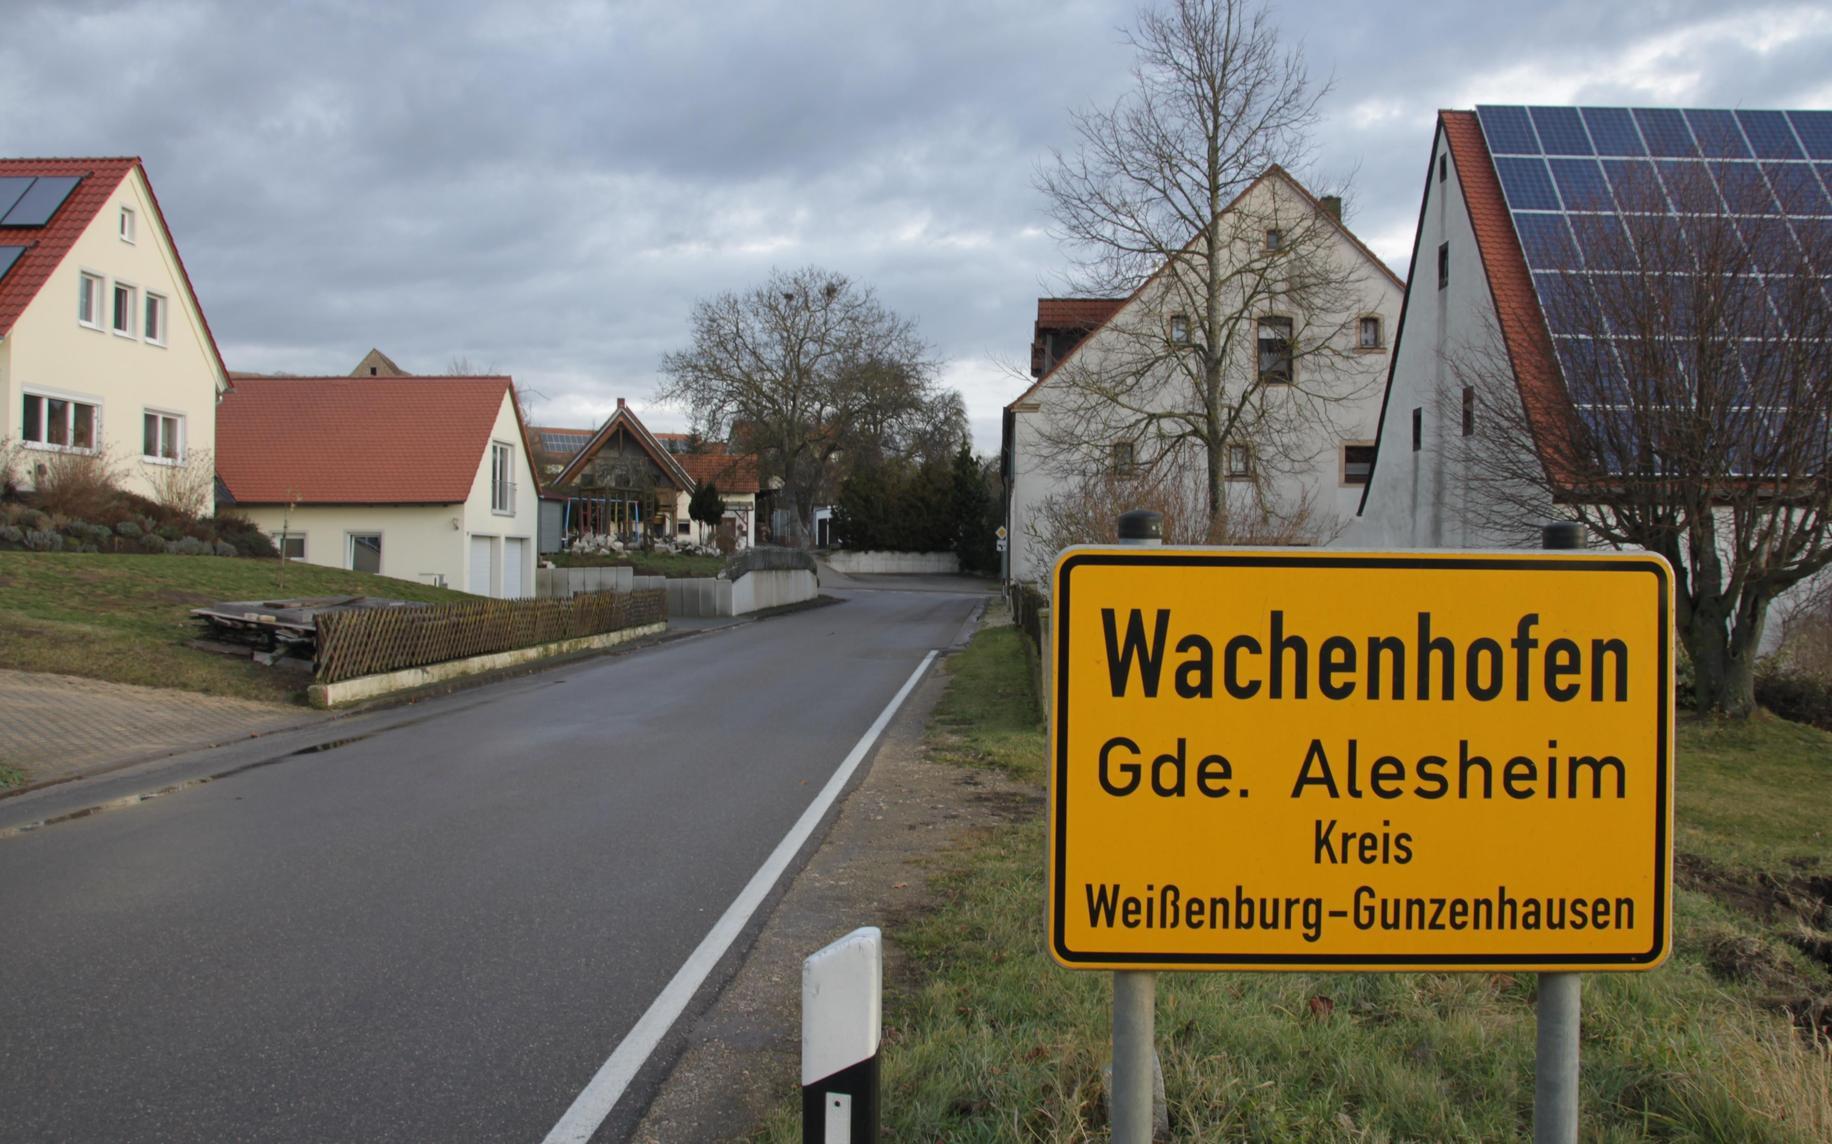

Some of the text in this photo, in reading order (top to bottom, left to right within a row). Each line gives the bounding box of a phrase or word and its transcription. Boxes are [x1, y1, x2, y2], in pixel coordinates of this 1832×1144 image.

[1101, 608, 1628, 702] Wachenhofen
[1098, 737, 1626, 799] Gde. Alesheim
[1314, 820, 1413, 865] Kreis
[1085, 884, 1635, 942] Weißenburg-Gunzenhausen
